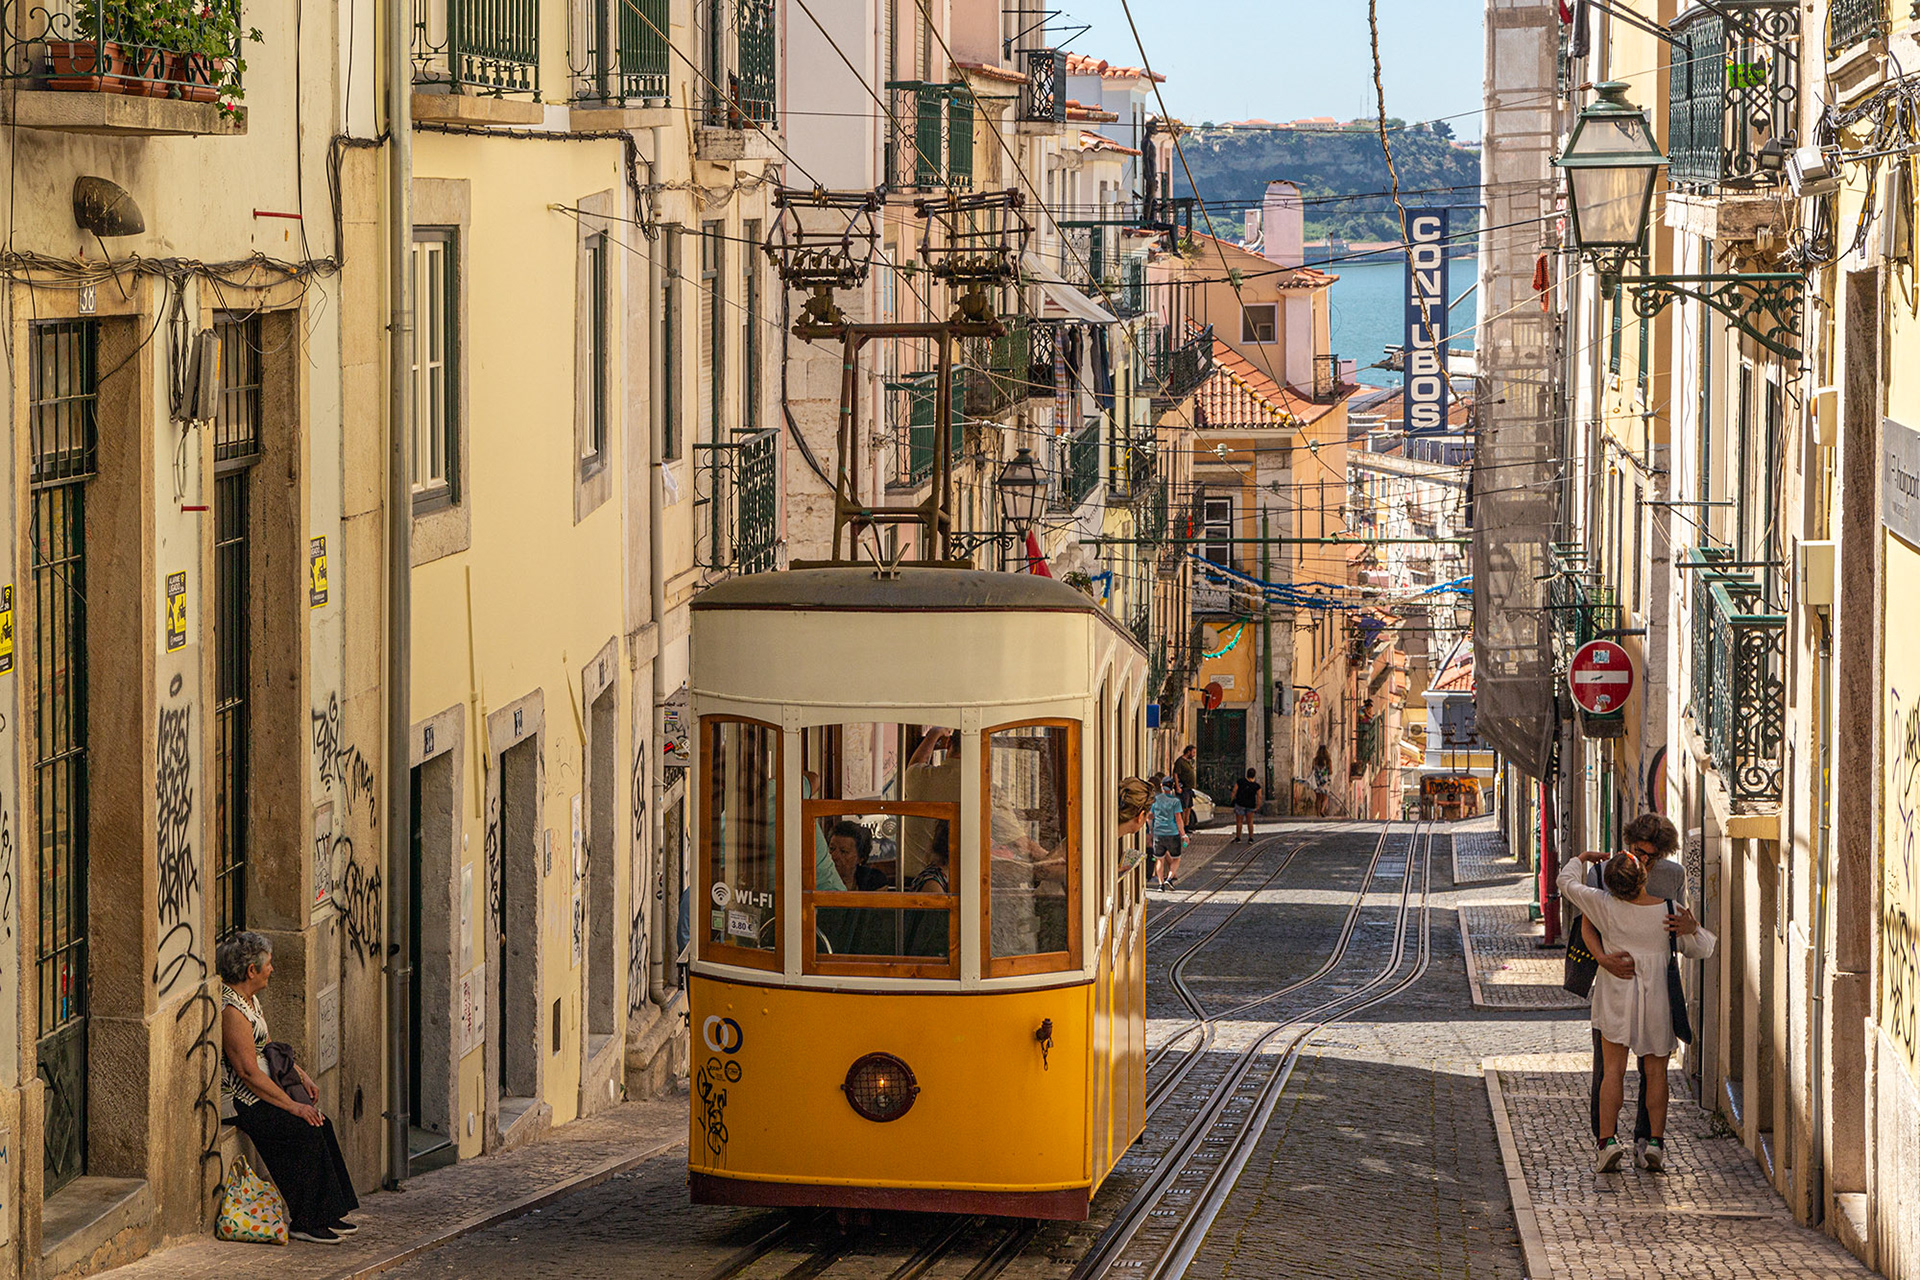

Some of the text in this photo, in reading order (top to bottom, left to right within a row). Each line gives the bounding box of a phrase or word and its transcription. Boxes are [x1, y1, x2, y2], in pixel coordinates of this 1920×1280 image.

[1410, 216, 1442, 428] CONTUBOS
[735, 889, 772, 908] WI-FI
[731, 920, 747, 931] 3.80
